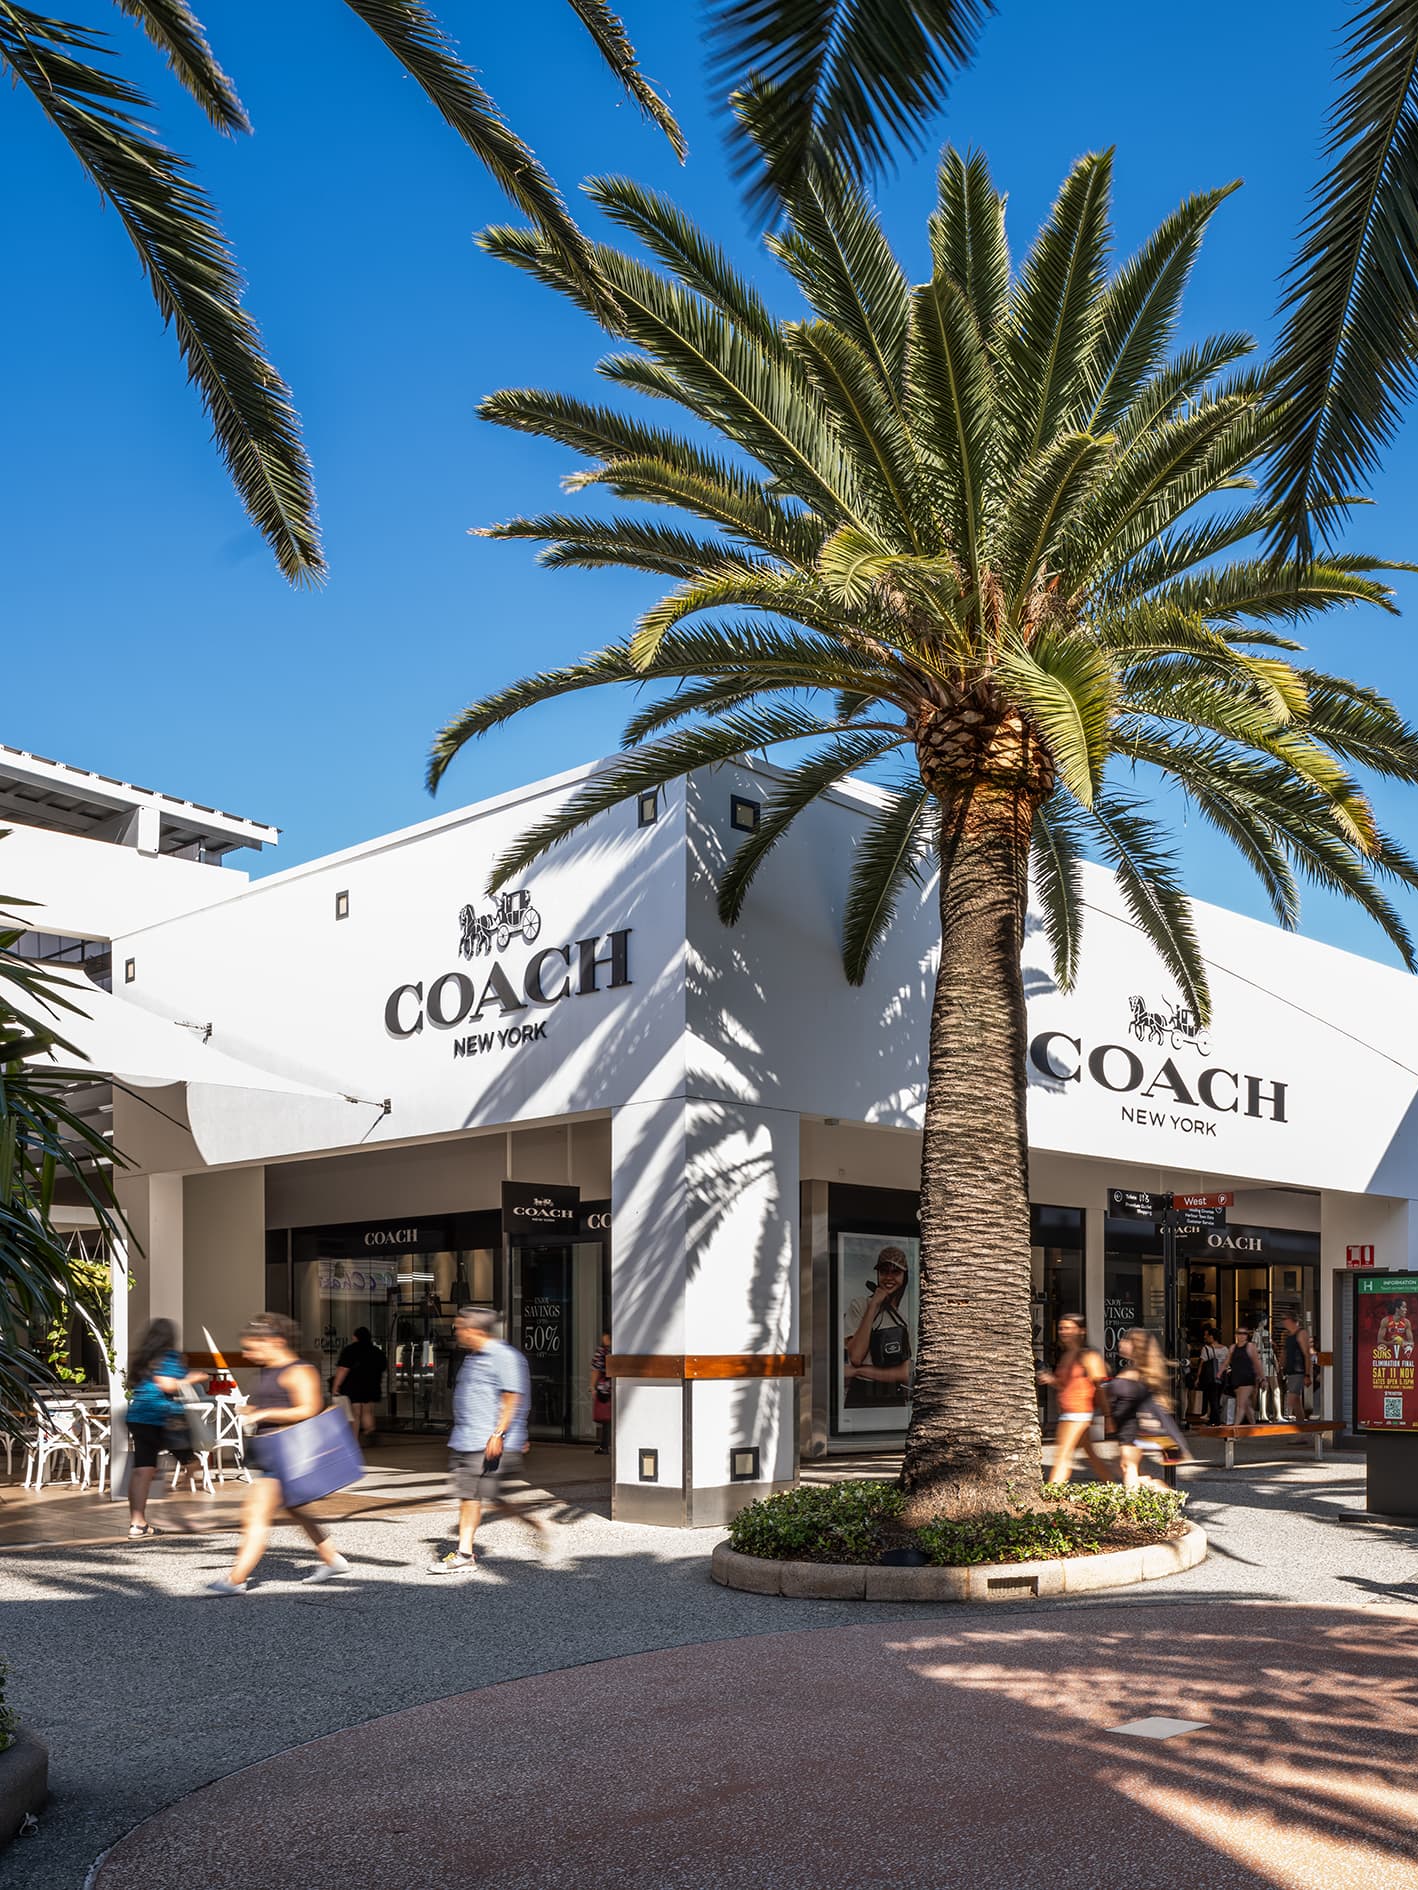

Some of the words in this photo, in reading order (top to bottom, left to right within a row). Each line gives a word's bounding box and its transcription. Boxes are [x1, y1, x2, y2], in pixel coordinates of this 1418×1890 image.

[385, 928, 633, 1037] COACH
[454, 1031, 495, 1058] NEW
[498, 1021, 548, 1047] YORK
[1030, 1031, 1289, 1124] COACH
[1121, 1105, 1166, 1128] NEW
[1170, 1115, 1217, 1137] YORK
[1183, 1196, 1207, 1206] West
[513, 1206, 574, 1219] COACH
[364, 1228, 418, 1246] COACH
[1159, 1225, 1201, 1234] CACH
[1207, 1233, 1263, 1251] OACH
[524, 1304, 561, 1318] SAVINGS
[524, 1325, 561, 1352] 50%
[1372, 1348, 1392, 1360] SUNS
[1393, 1344, 1400, 1359] V
[1372, 1367, 1386, 1378] SAT
[1390, 1367, 1396, 1378] 11
[1400, 1367, 1415, 1378] NOV
